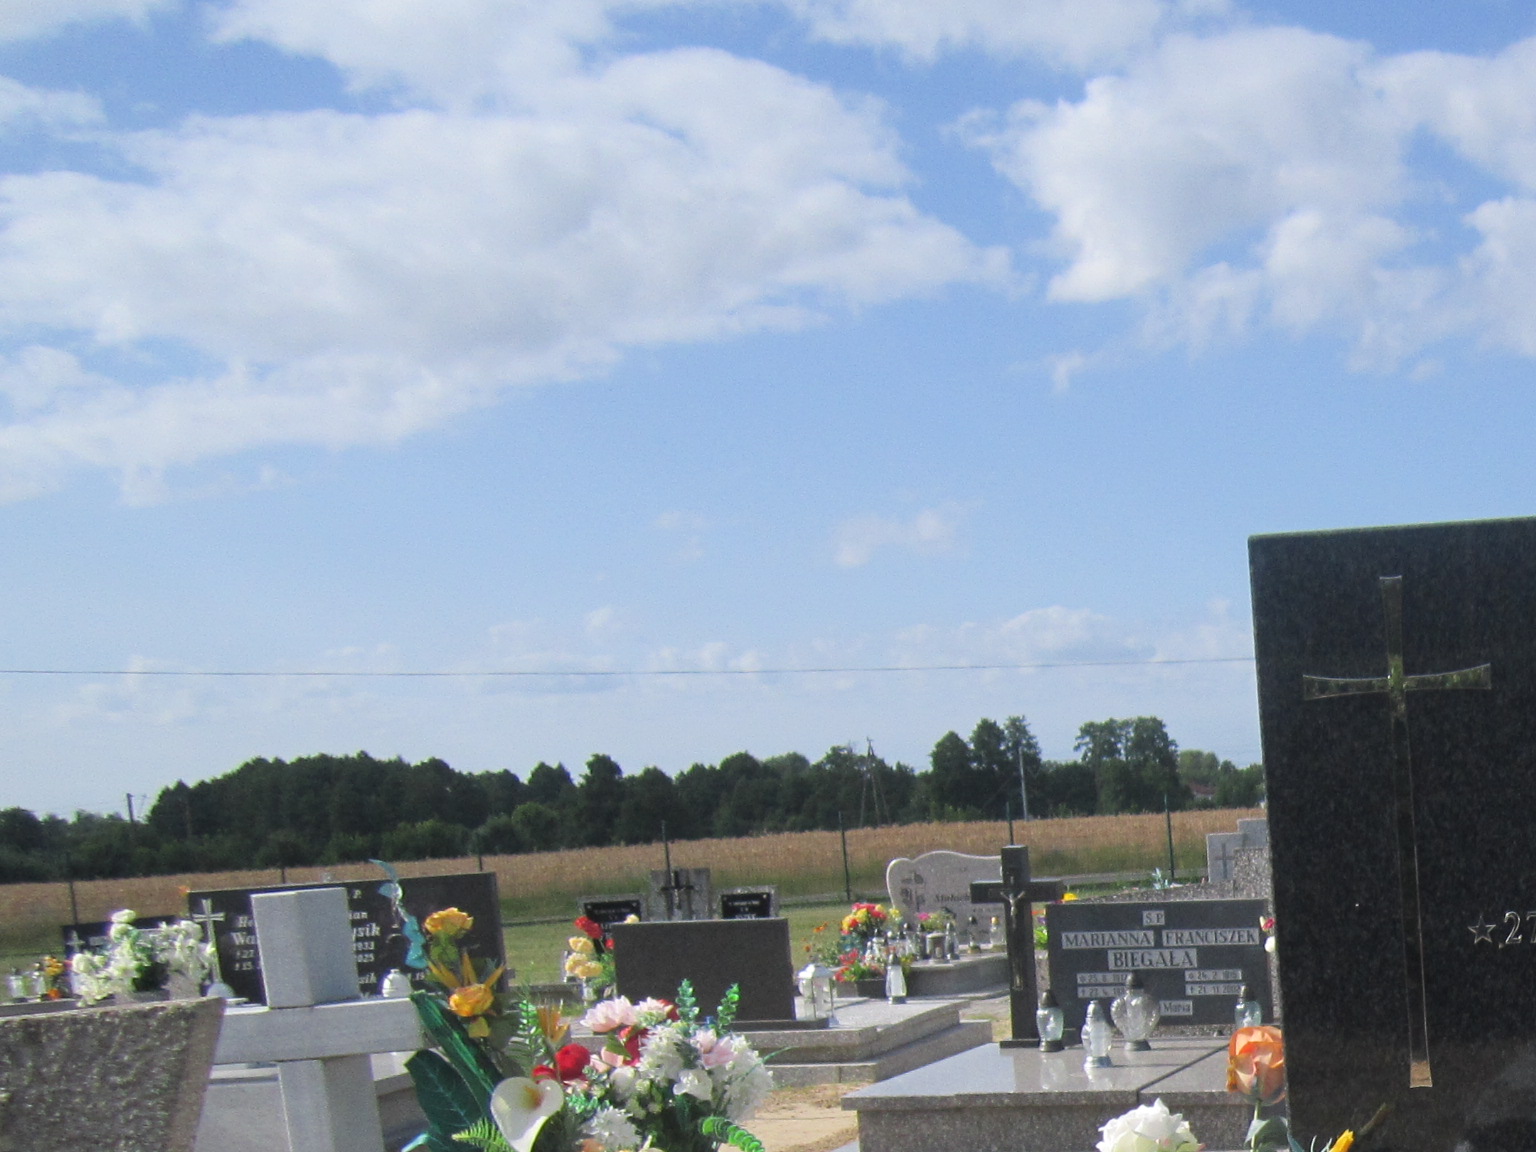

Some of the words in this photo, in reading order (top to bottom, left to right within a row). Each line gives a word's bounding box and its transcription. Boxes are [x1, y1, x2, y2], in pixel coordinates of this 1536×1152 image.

[1064, 932, 1153, 948] MARIANNA
[1165, 928, 1258, 945] FRANCISZEK
[1113, 950, 1195, 968] BIEGAŁA
